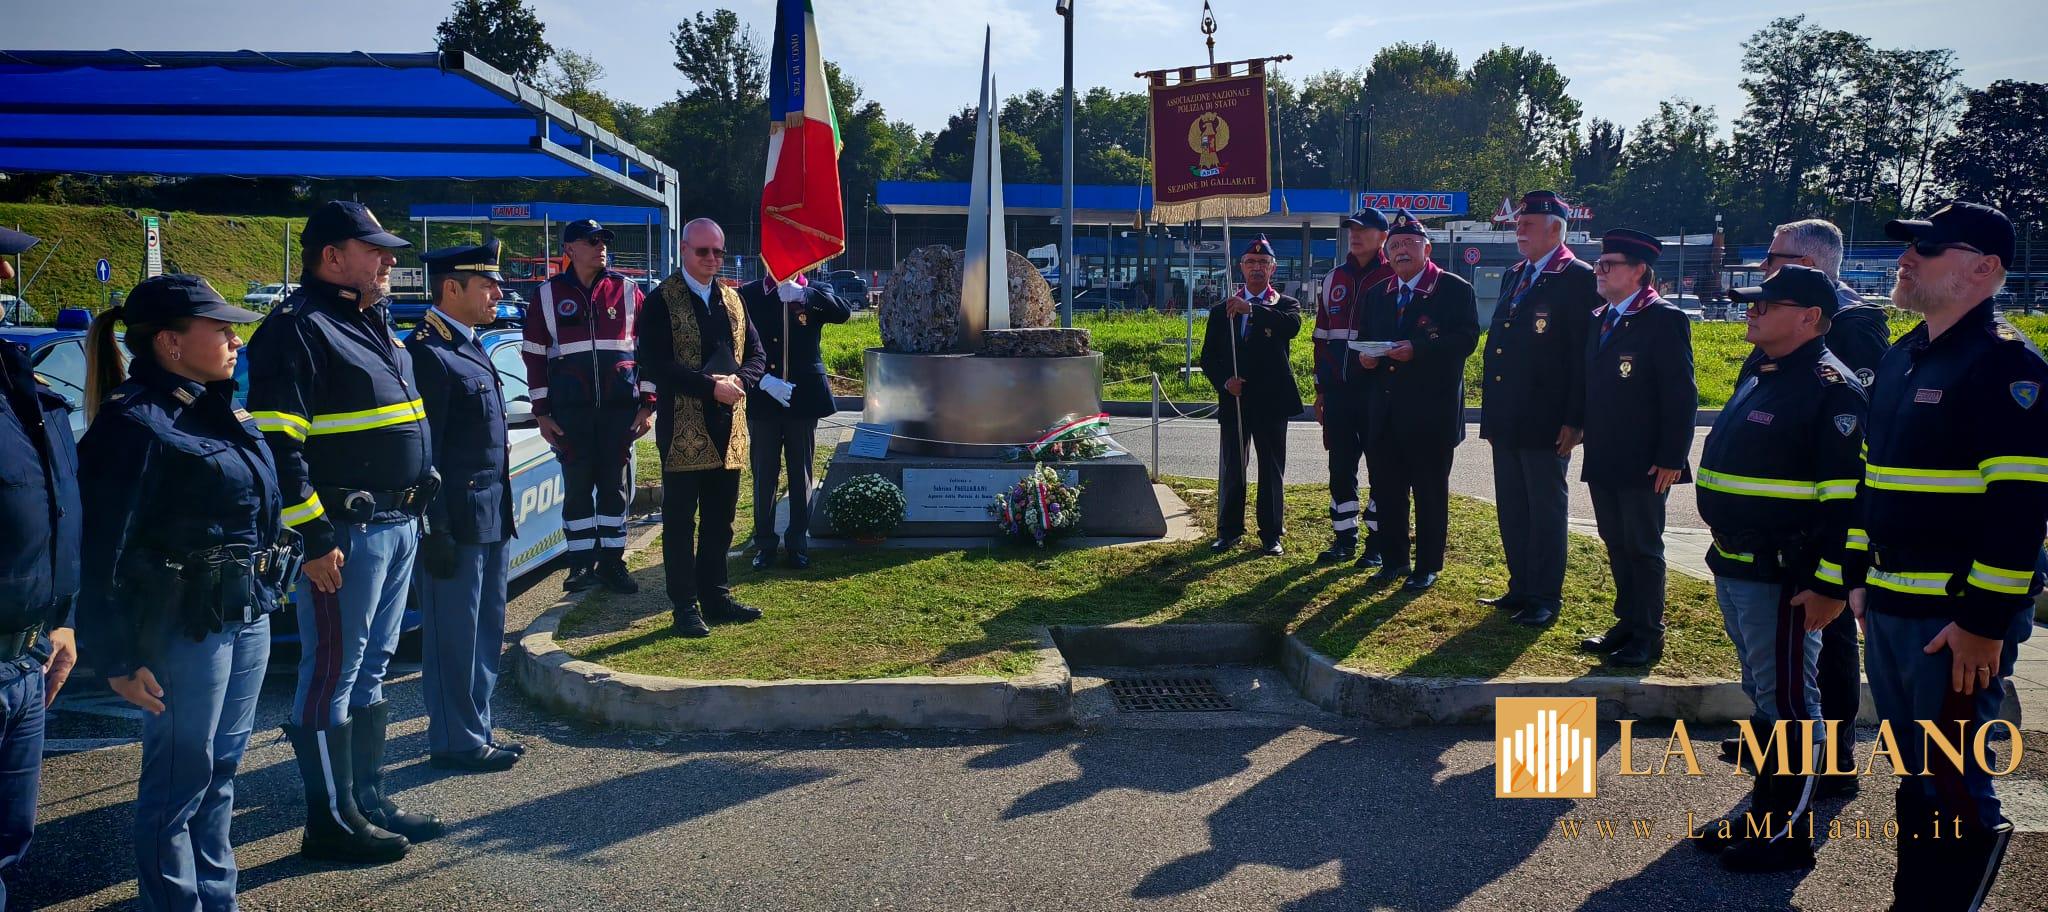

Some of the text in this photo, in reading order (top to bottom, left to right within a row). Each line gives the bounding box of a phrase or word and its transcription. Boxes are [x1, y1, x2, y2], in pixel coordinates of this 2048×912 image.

[1167, 88, 1250, 106] ASSOCIAZIONE NAZIONALE
[1177, 99, 1237, 113] POLIZIA DI STATO
[1167, 177, 1256, 194] SEZIONE DI GALLARATE
[1363, 194, 1450, 210] TAMOIL
[492, 206, 529, 217] TAMOIL
